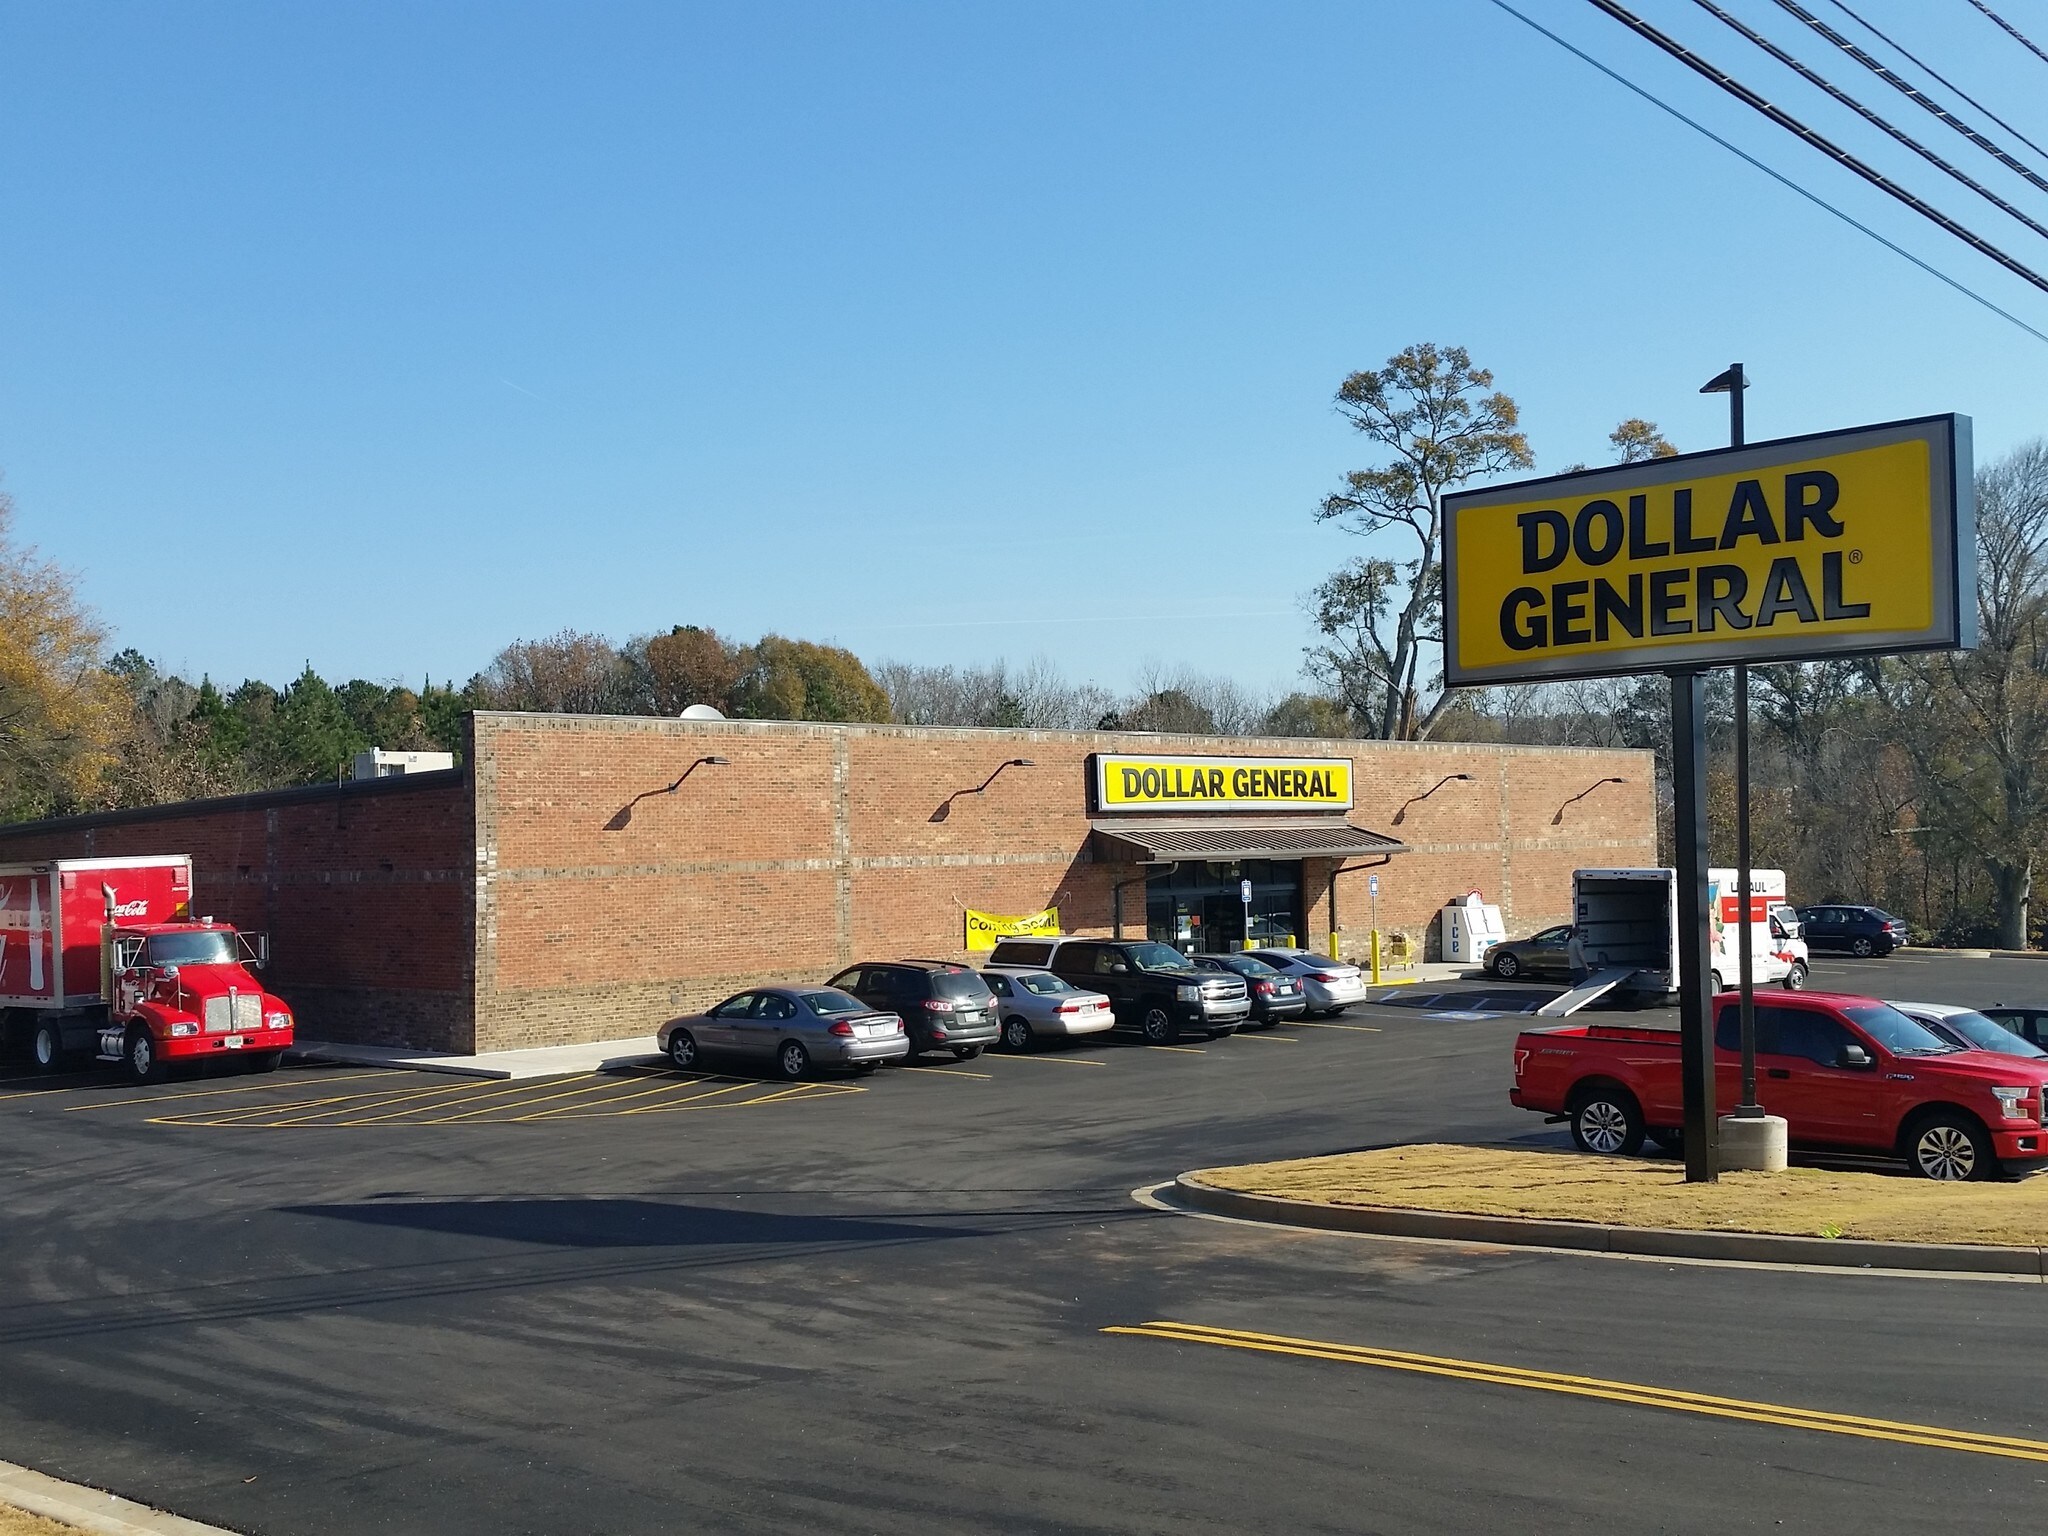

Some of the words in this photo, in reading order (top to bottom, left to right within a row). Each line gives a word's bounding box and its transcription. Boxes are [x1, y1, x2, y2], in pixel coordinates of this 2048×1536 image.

[1517, 470, 1845, 575] DOLLAR
[1500, 550, 1871, 651] GENERAL
[1122, 768, 1225, 798] DOLLAR
[1232, 769, 1337, 798] GENERAL
